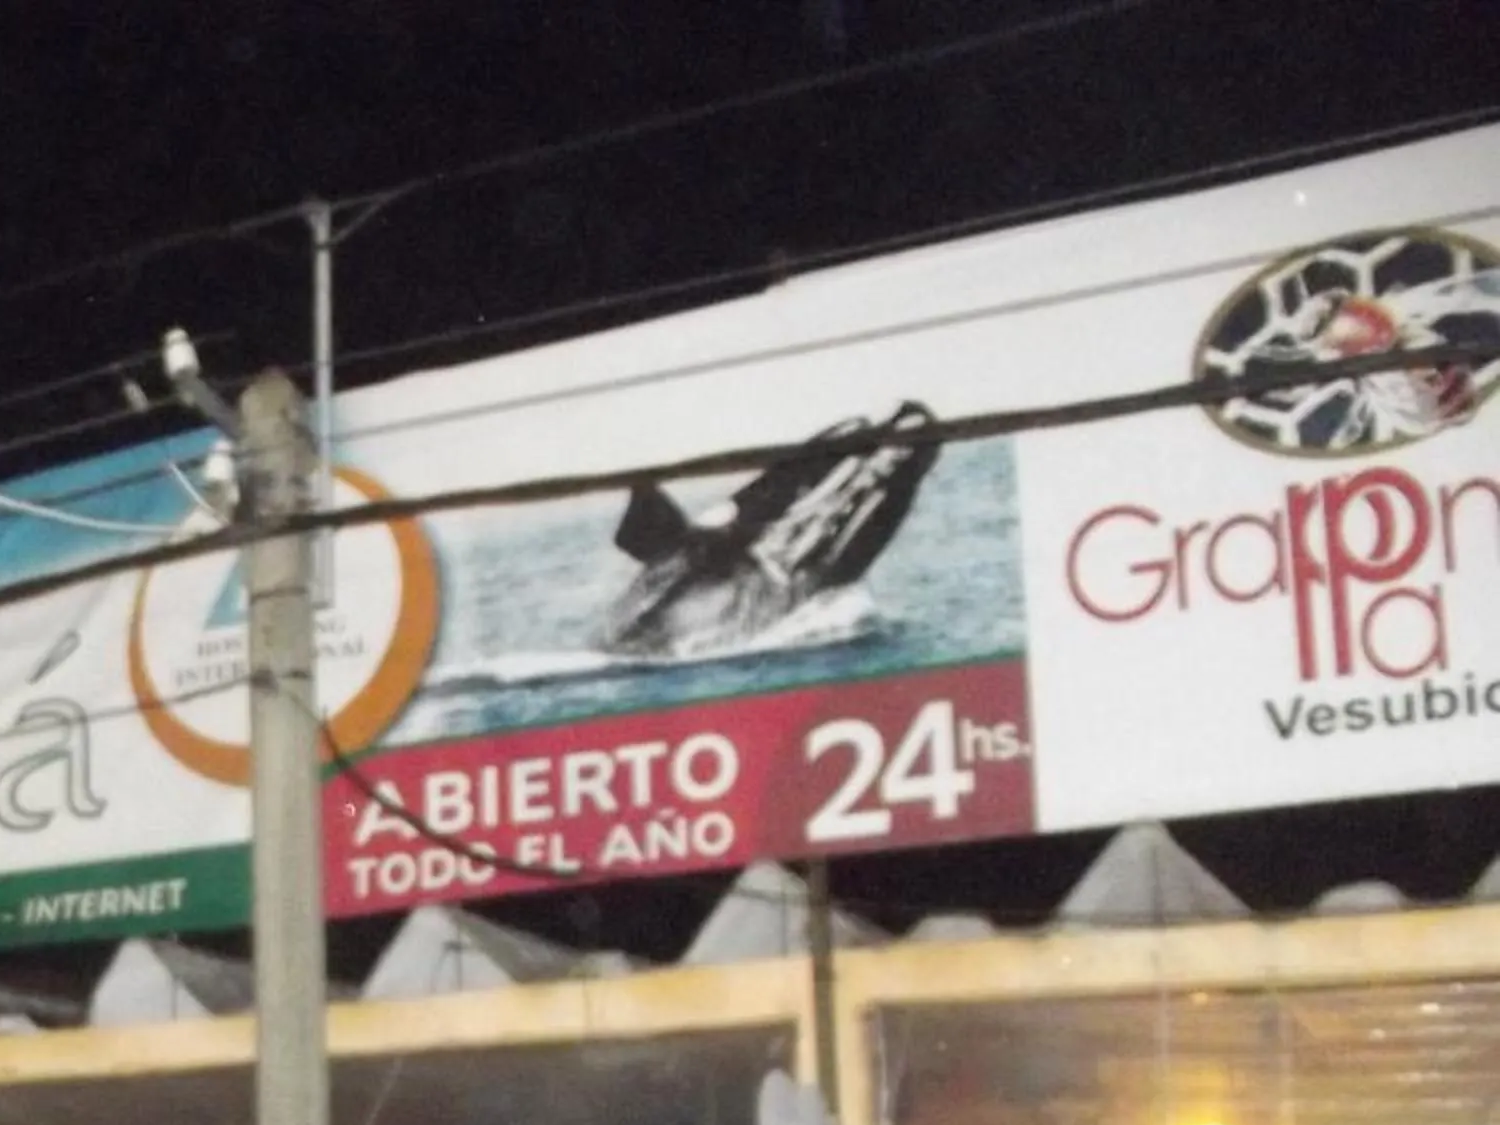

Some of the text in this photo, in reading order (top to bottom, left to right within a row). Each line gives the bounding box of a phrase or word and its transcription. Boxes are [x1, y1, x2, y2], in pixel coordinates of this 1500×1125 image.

[353, 732, 740, 847] ABIERTO
[347, 807, 736, 899] TODO EL AÑO
[20, 877, 189, 925] INTERNET
